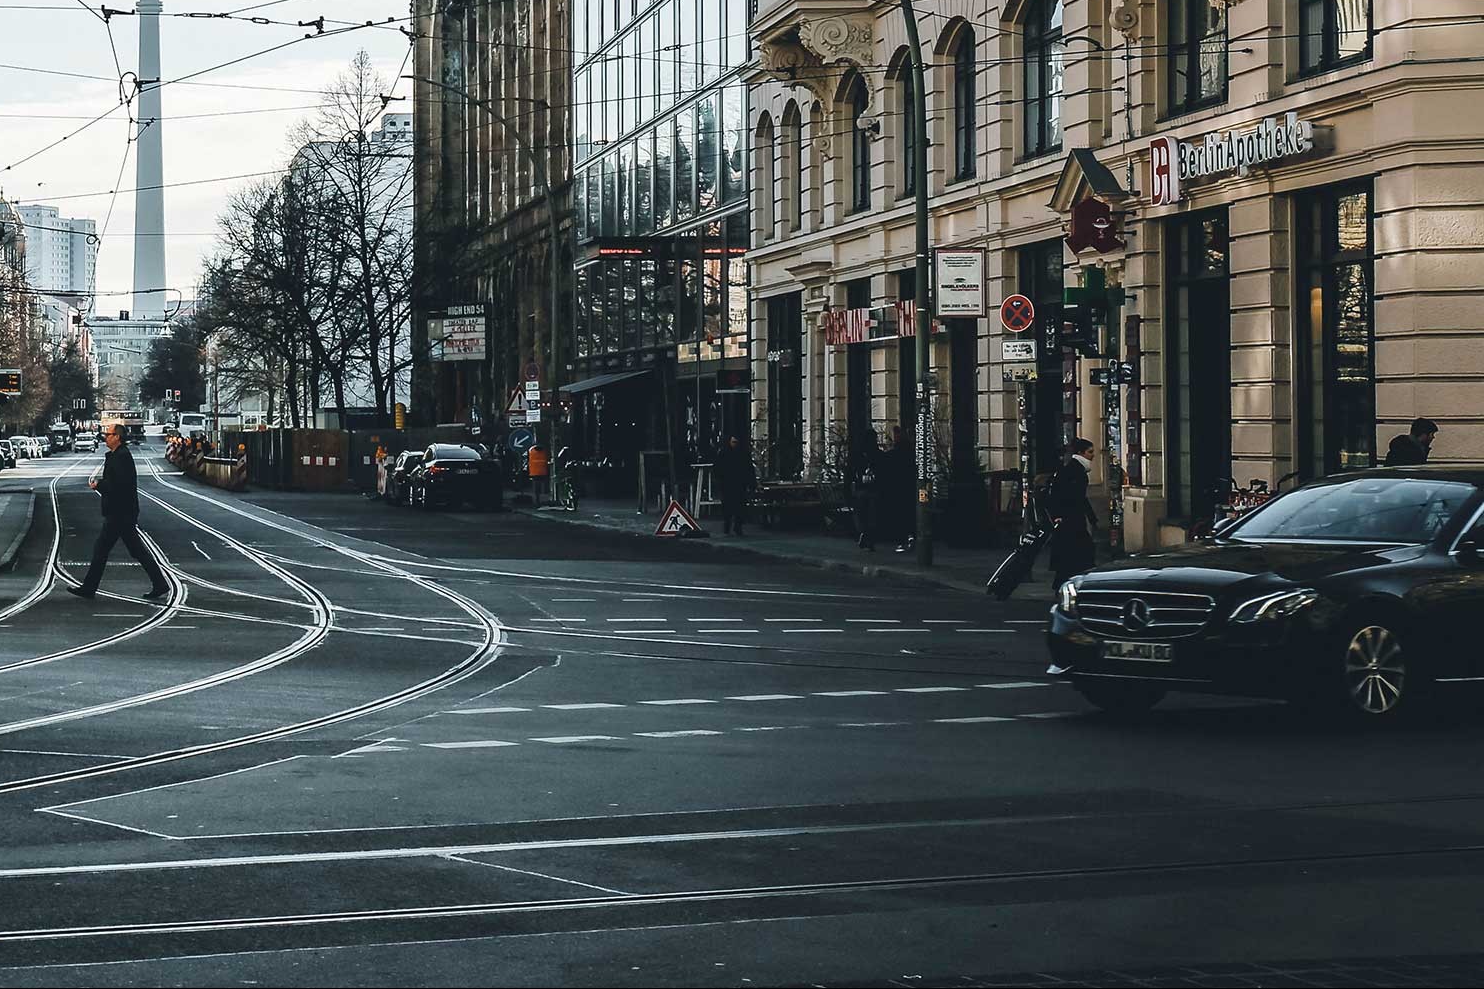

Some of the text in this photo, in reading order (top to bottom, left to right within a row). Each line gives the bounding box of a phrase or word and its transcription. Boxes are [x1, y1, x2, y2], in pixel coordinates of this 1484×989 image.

[1178, 114, 1306, 180] BerlinApotheke
[463, 305, 476, 315] END
[476, 304, 485, 315] 54
